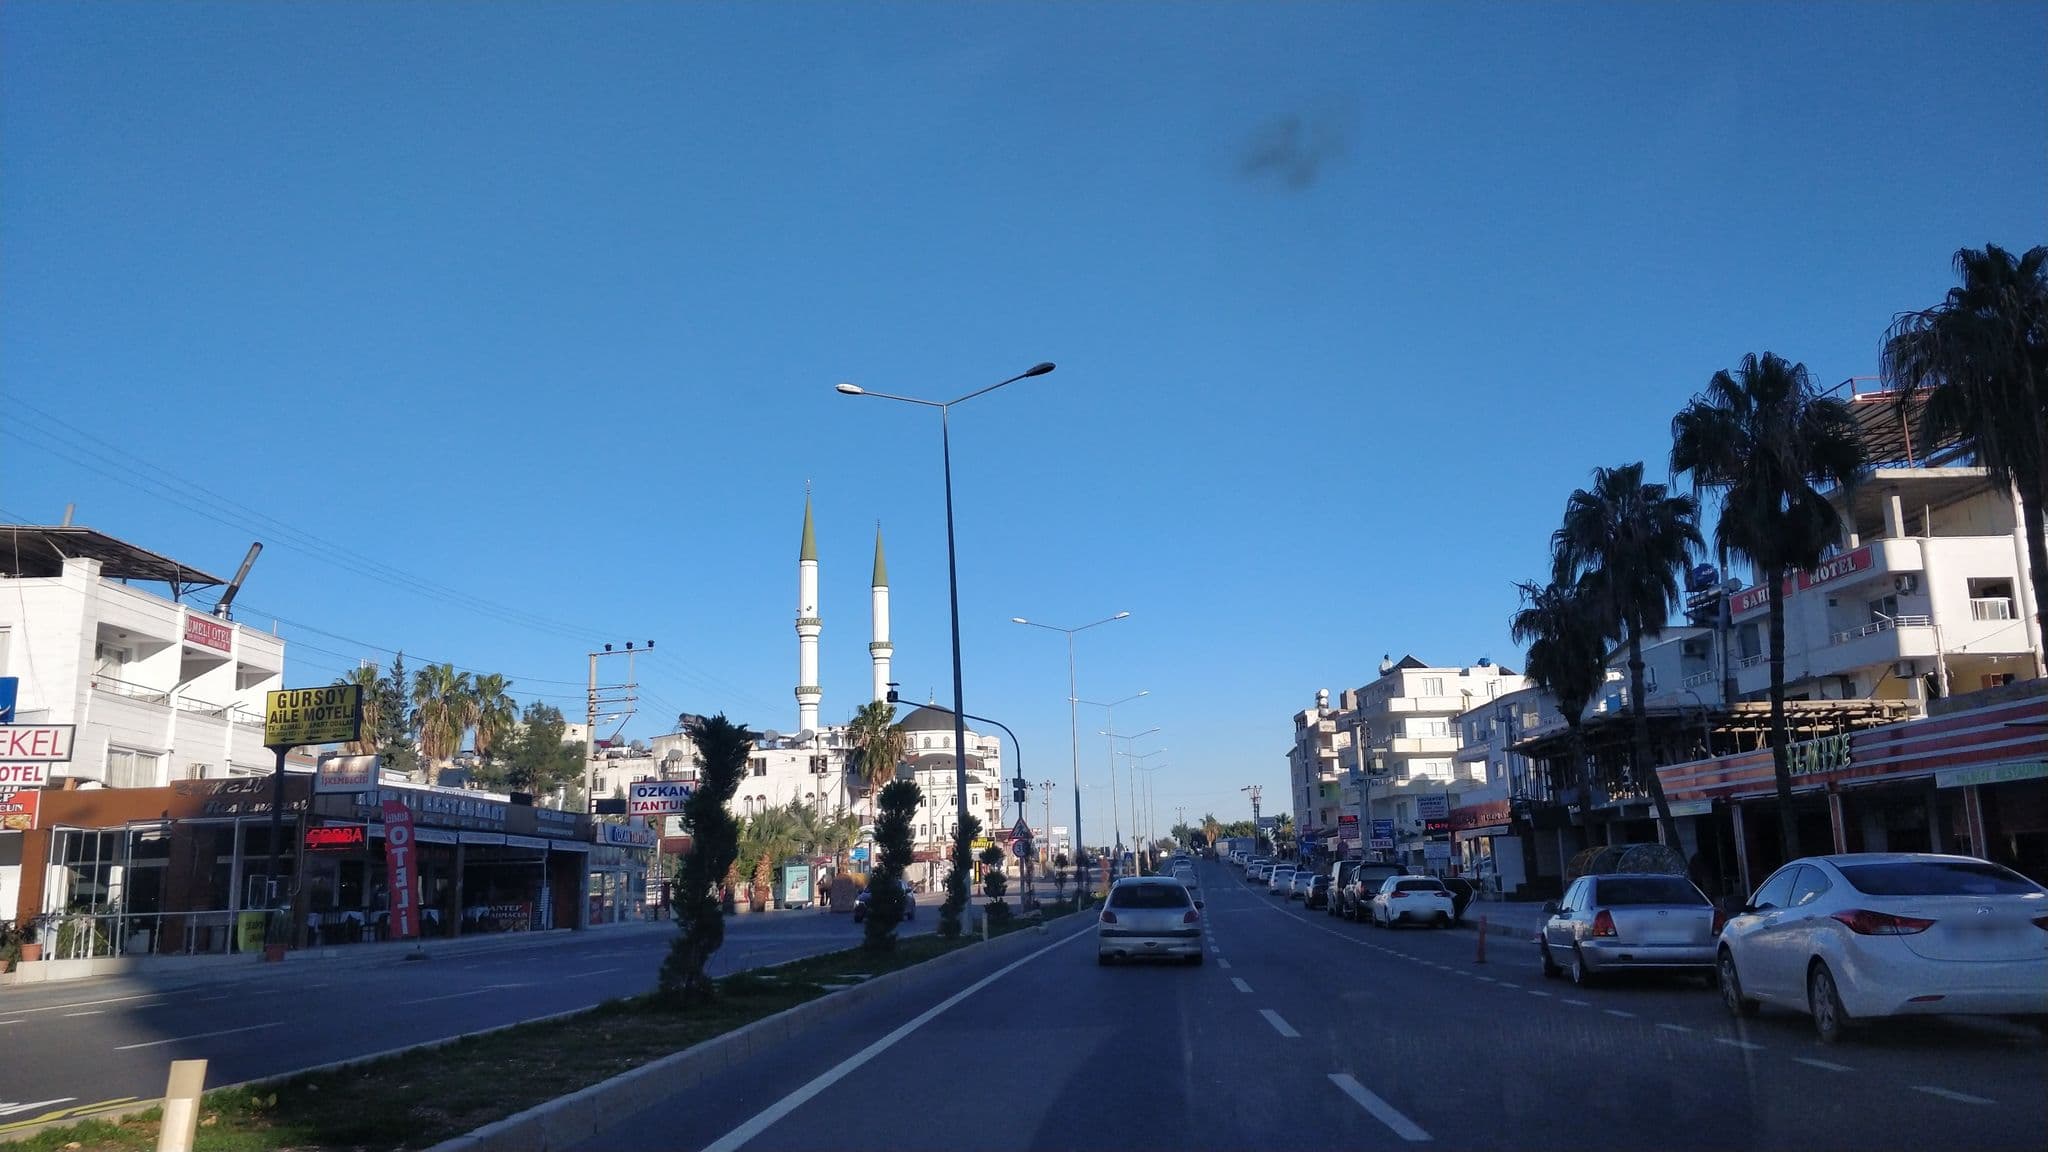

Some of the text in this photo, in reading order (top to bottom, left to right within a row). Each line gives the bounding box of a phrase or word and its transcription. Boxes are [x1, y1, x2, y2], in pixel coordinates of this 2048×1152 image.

[1809, 556, 1857, 585] MOTEL
[0, 792, 16, 802] P
[637, 785, 690, 798] ÖZKAN
